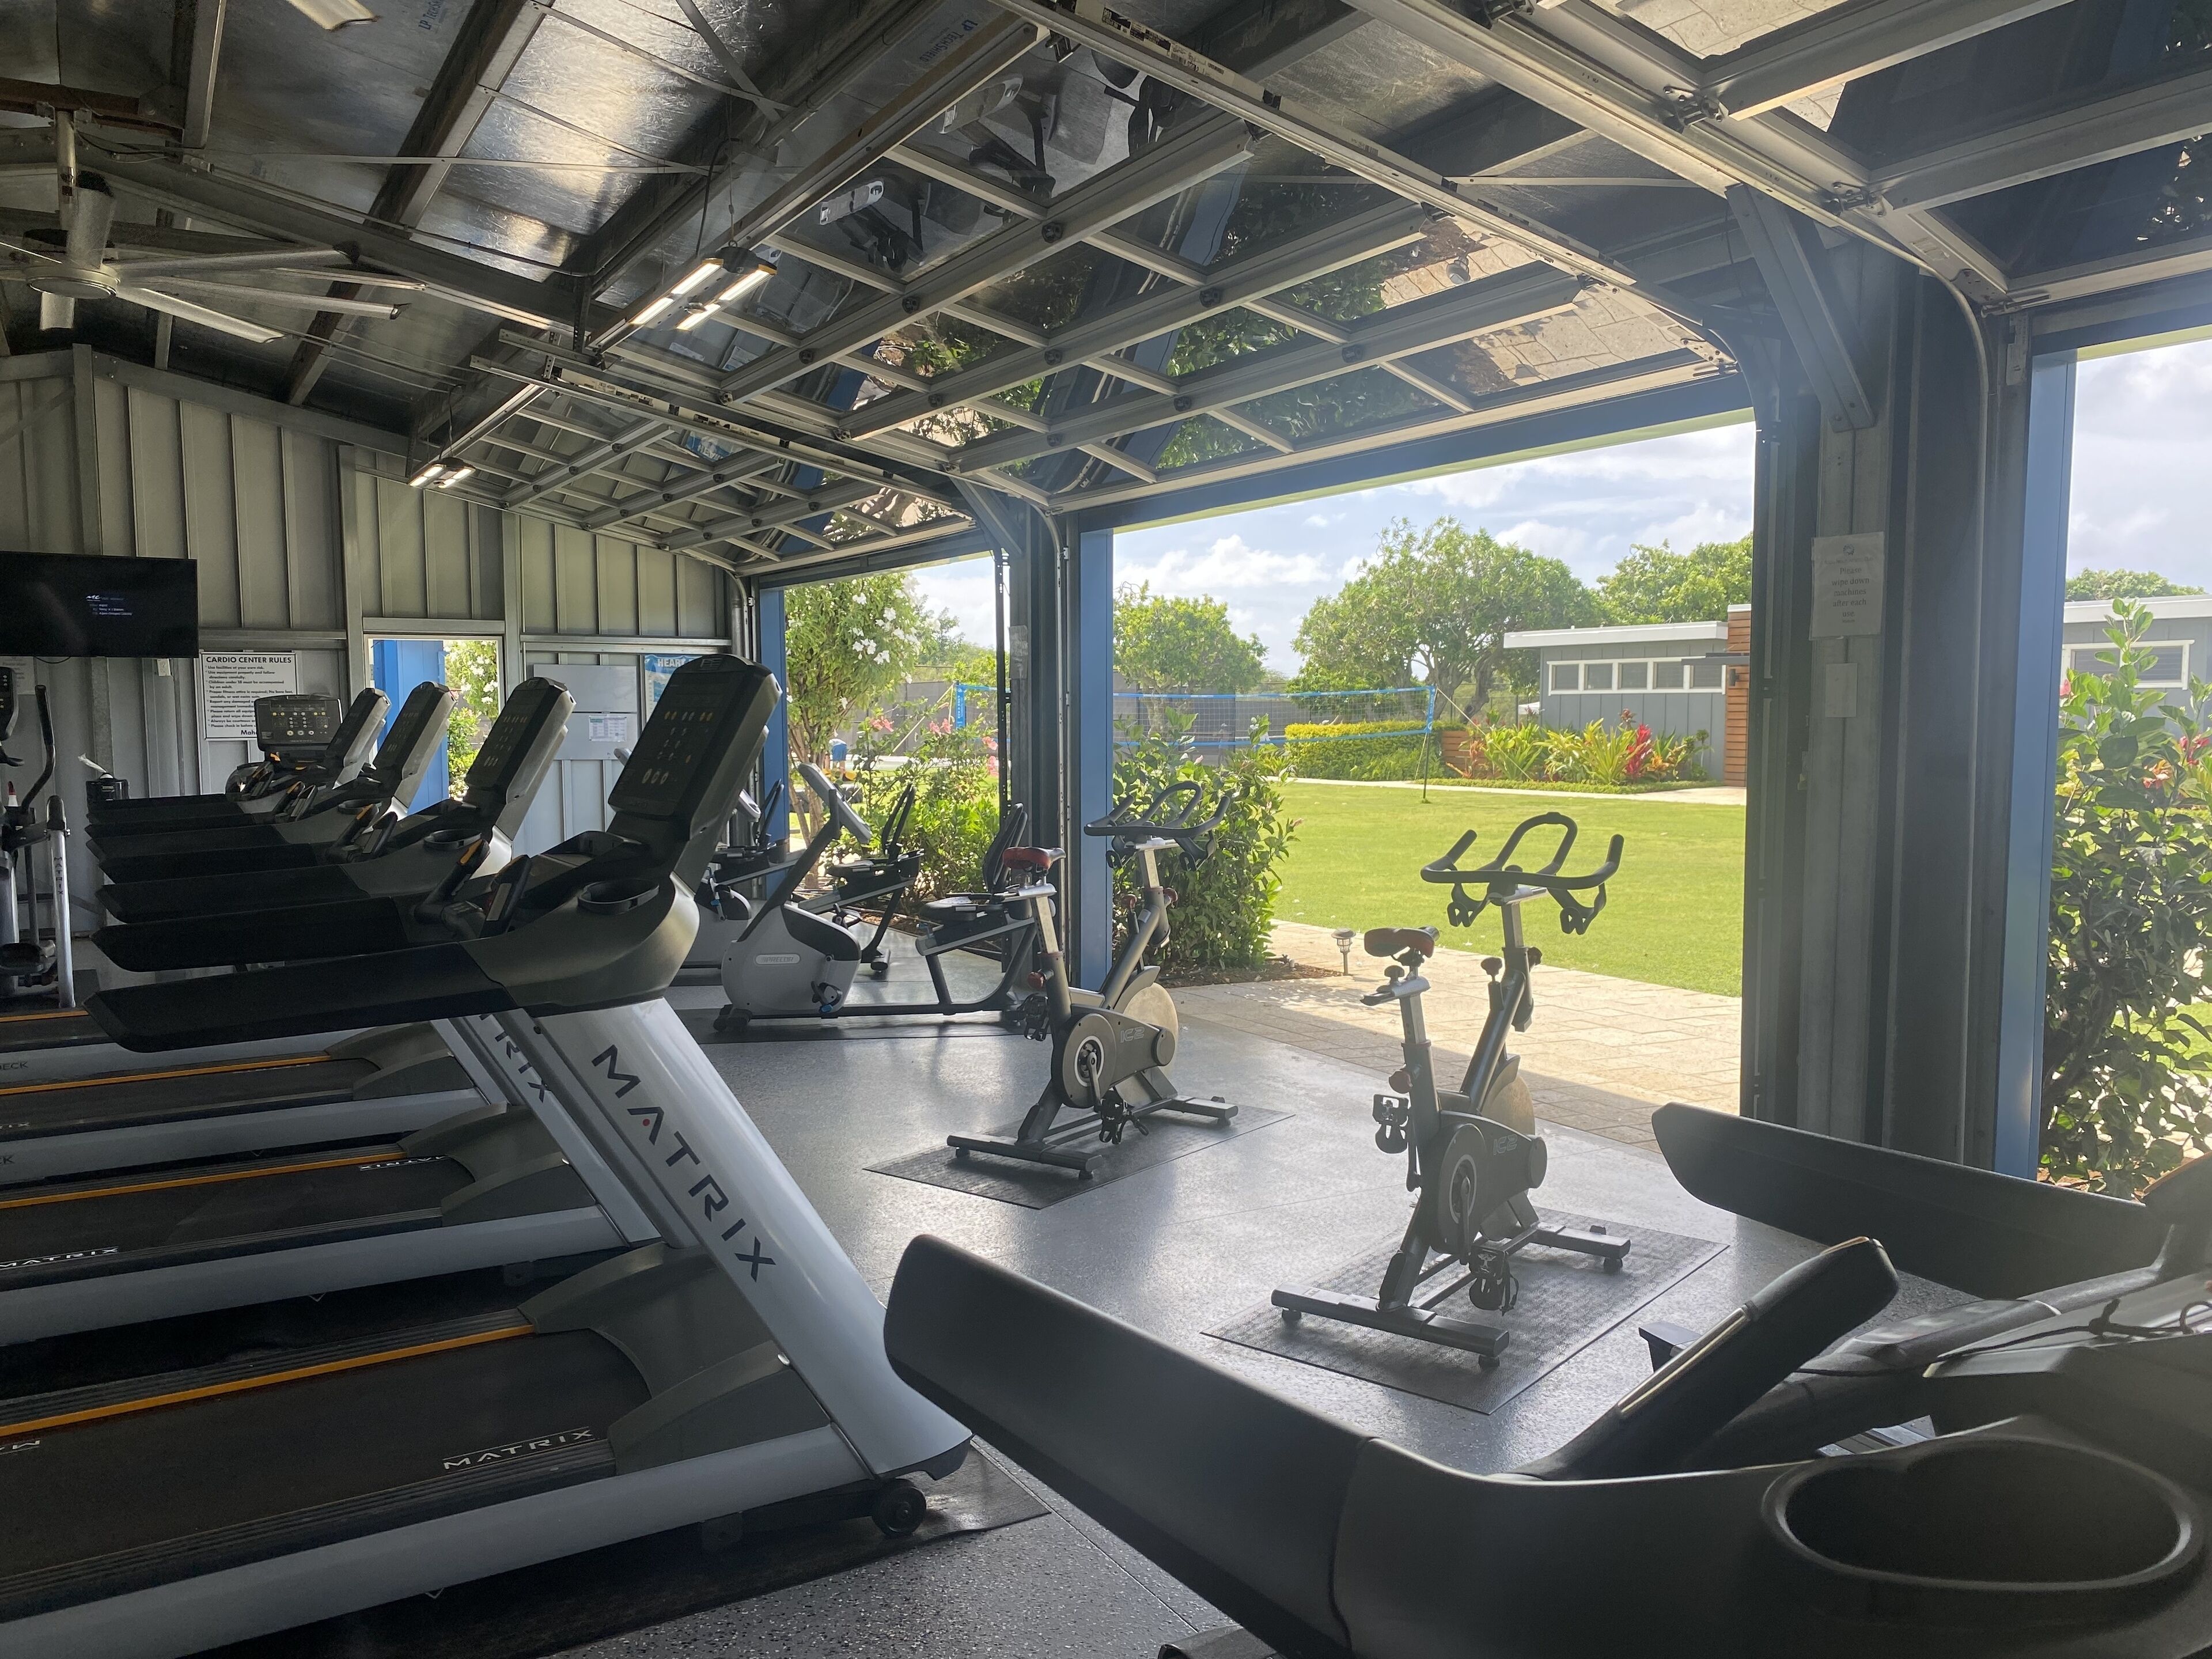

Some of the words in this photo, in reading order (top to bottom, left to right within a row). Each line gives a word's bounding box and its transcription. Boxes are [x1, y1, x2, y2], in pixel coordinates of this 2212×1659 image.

[418, 20, 432, 30] LP
[961, 19, 978, 31] LP
[1834, 588, 1866, 596] machines
[591, 1043, 776, 1282] MATRIX
[444, 1429, 592, 1469] MATRIX
